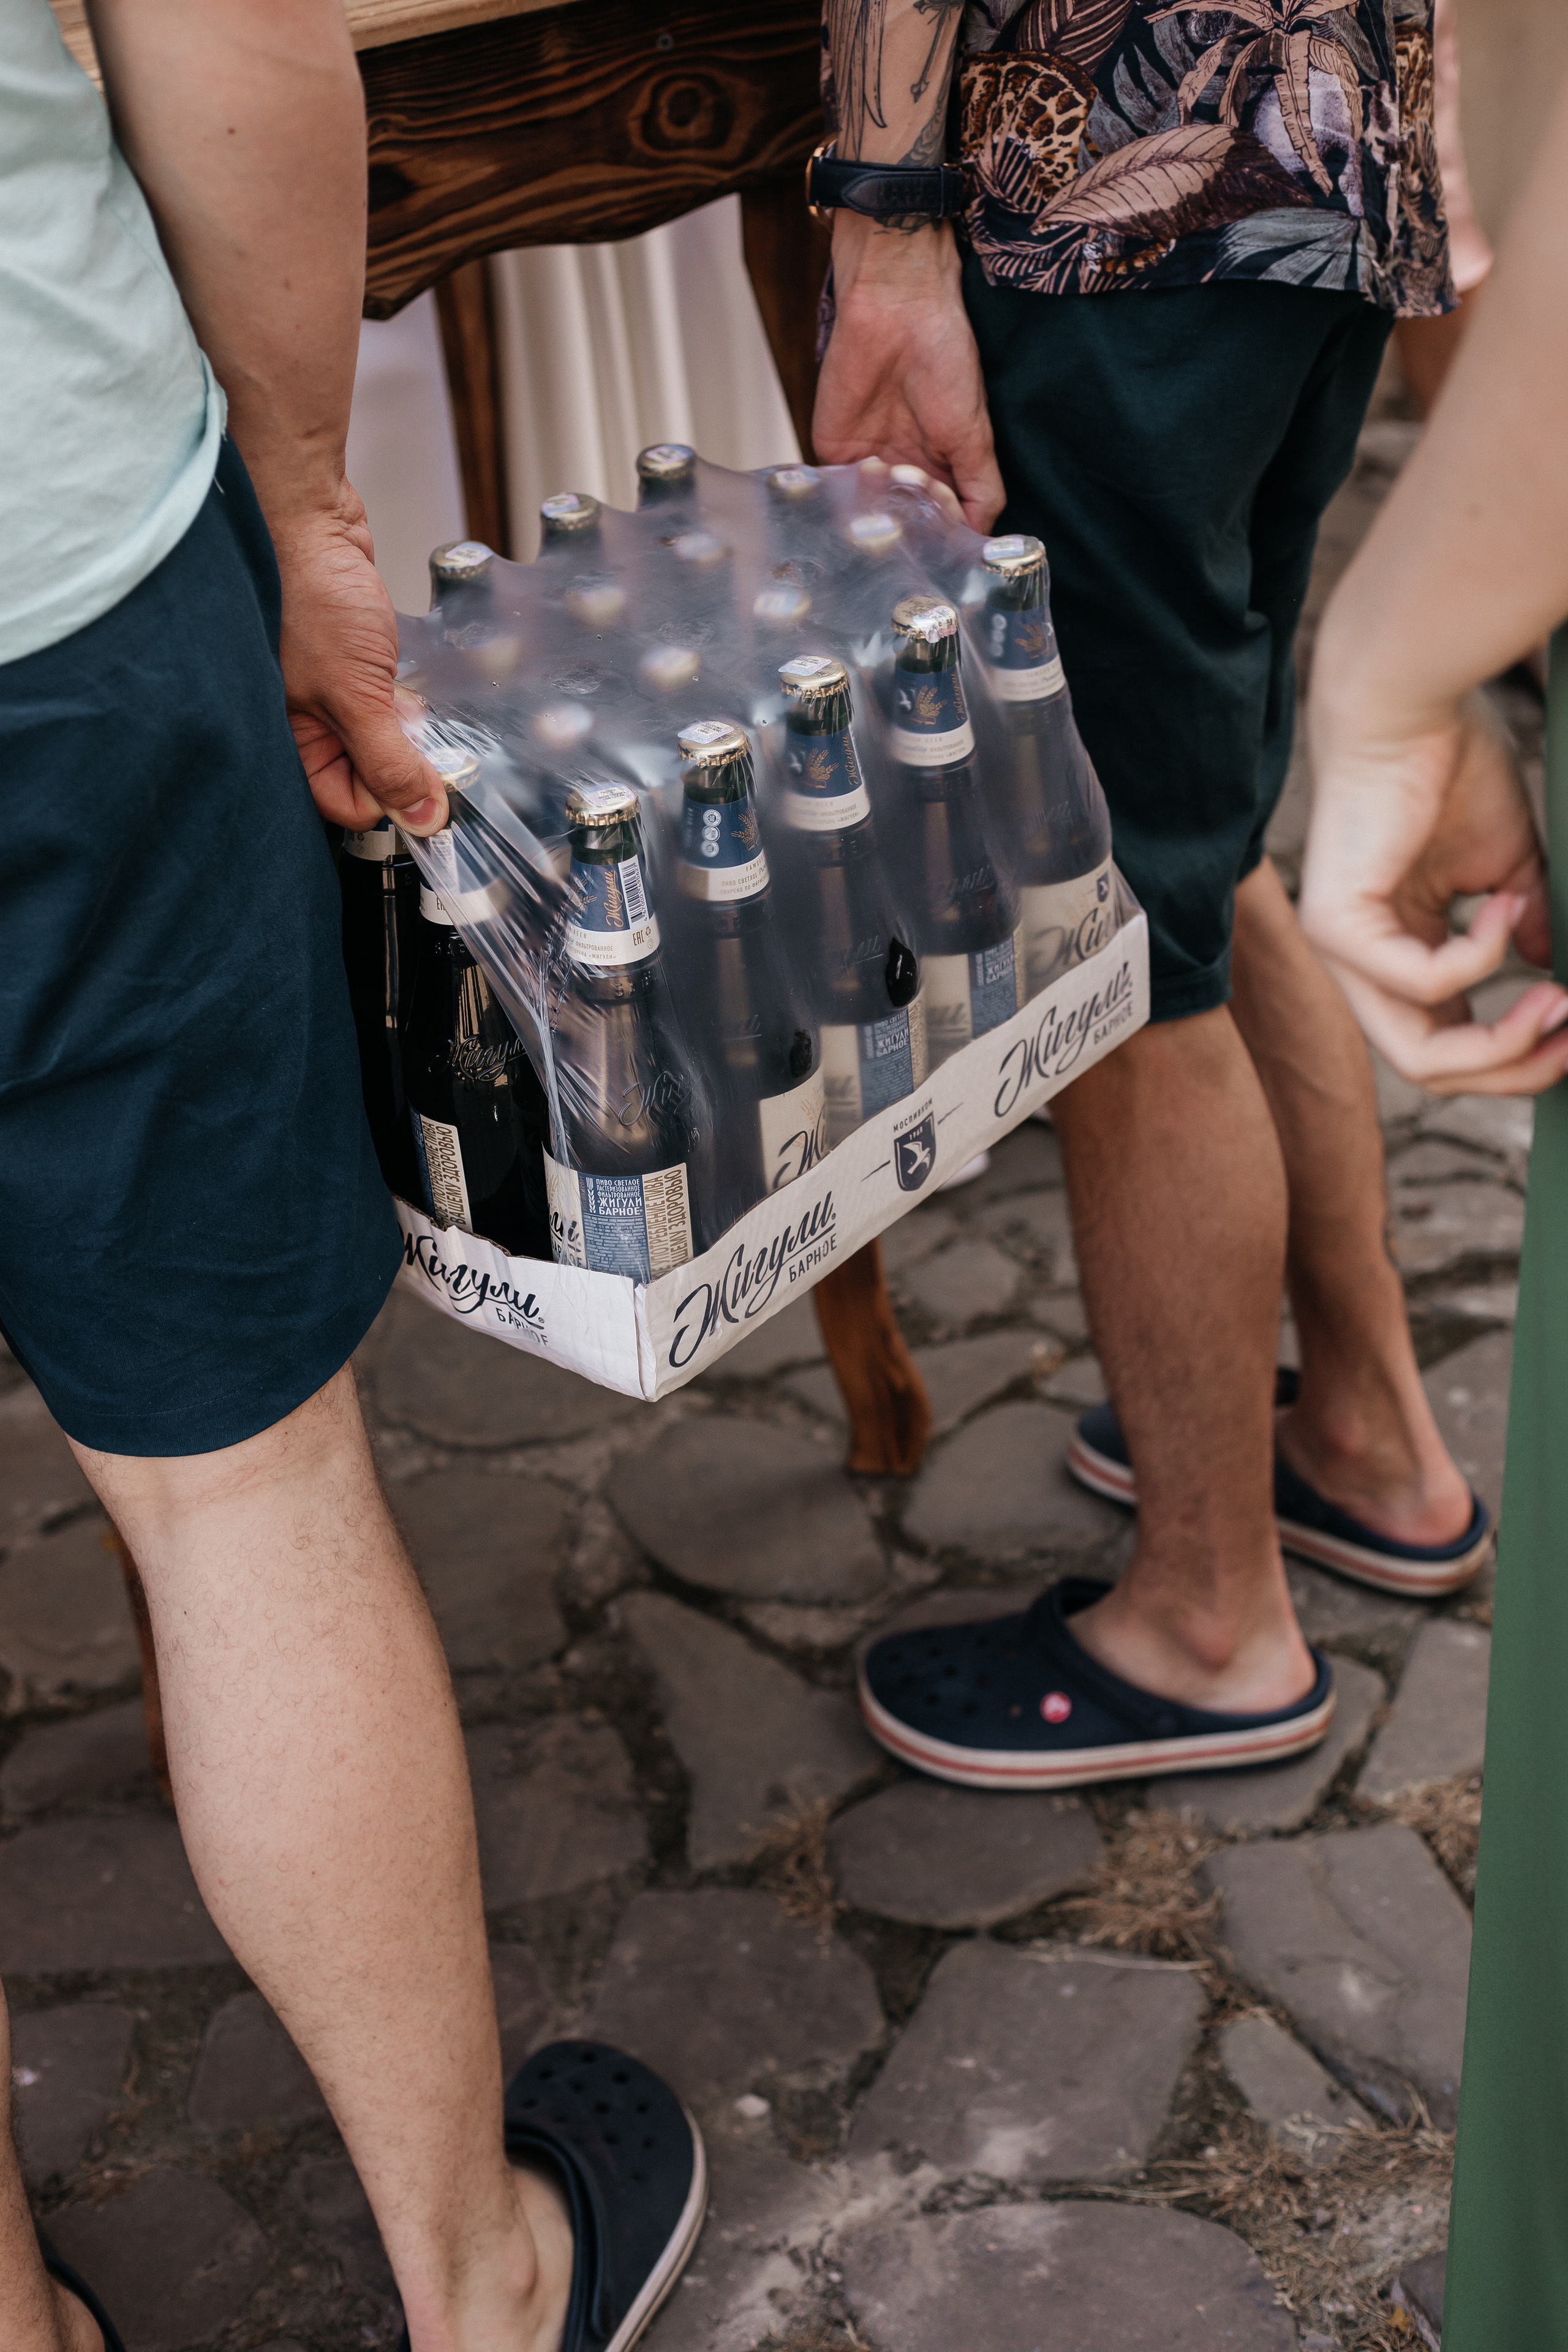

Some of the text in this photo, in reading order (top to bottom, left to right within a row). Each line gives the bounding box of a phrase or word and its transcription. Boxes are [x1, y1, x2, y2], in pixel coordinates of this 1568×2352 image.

[603, 869, 625, 928] Жигули
[738, 873, 758, 885] СВЕТЛОЕ
[576, 940, 614, 952] ФИЛЬТРОВАННОЕ
[994, 961, 1132, 1117] Жигули
[421, 1120, 438, 1145] ПИВА
[893, 1098, 933, 1133] МОСПИВКОМ
[425, 1143, 447, 1206] УПОТРЕБЛЕНИЕ
[435, 1126, 461, 1182] ЗДОРОВЬЮ
[443, 1181, 466, 1225] ВАШЕМУ
[597, 1196, 642, 1207] «ЖИГУЛИ
[598, 1206, 643, 1216] БАРНОЕ»
[643, 1175, 665, 1201] ПИВА
[663, 1169, 687, 1231] ЗДОРОВЬЮ
[646, 1200, 671, 1266] УПОТРЕБЛЕНИЕ
[669, 1191, 835, 1368] Жигули
[789, 1232, 838, 1283] БАРНОЕ
